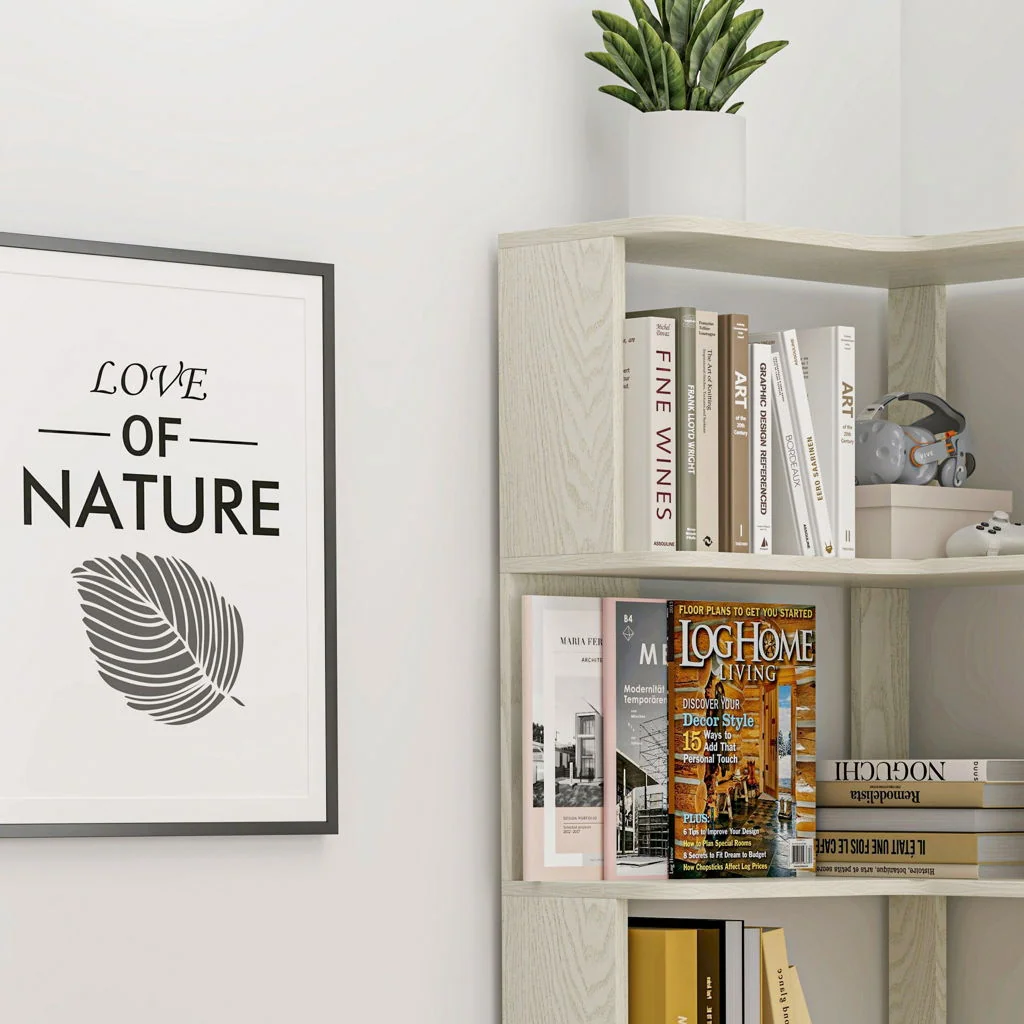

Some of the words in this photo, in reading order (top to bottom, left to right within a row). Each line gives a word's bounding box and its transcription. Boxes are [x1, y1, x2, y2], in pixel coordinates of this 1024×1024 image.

[91, 361, 207, 401] LOVE
[656, 351, 671, 413] FINE
[735, 371, 747, 409] ART
[687, 385, 695, 411] FRANK
[841, 382, 853, 418] ART
[122, 415, 182, 458] OF
[687, 414, 695, 439] LLOYD
[687, 442, 695, 474] WRIGHT
[786, 435, 800, 487] BORDEAUX
[806, 437, 819, 478] SAARINEN
[656, 427, 671, 519] WINES
[23, 466, 280, 536] NATURE
[815, 481, 823, 501] EERO
[679, 605, 703, 615] FLOOR
[707, 606, 730, 616] PLANS
[734, 607, 743, 616] TO
[746, 607, 760, 617] GET
[763, 608, 777, 617] YOU
[779, 609, 812, 618] STARTED
[560, 637, 585, 645] MARIA
[720, 664, 776, 681] LIVING
[683, 698, 718, 709] DISCOVER
[720, 698, 739, 709] YOUR
[683, 713, 719, 726] Decor
[722, 714, 754, 730] Style
[683, 731, 701, 751] 15
[704, 730, 722, 740] Ways
[704, 742, 717, 751] Add
[720, 742, 736, 751] That
[683, 754, 714, 763] Personal
[717, 755, 737, 763] Touch
[836, 762, 946, 781] NOGUCHI
[851, 791, 920, 803] Remodelista
[683, 814, 710, 823] PLUS:
